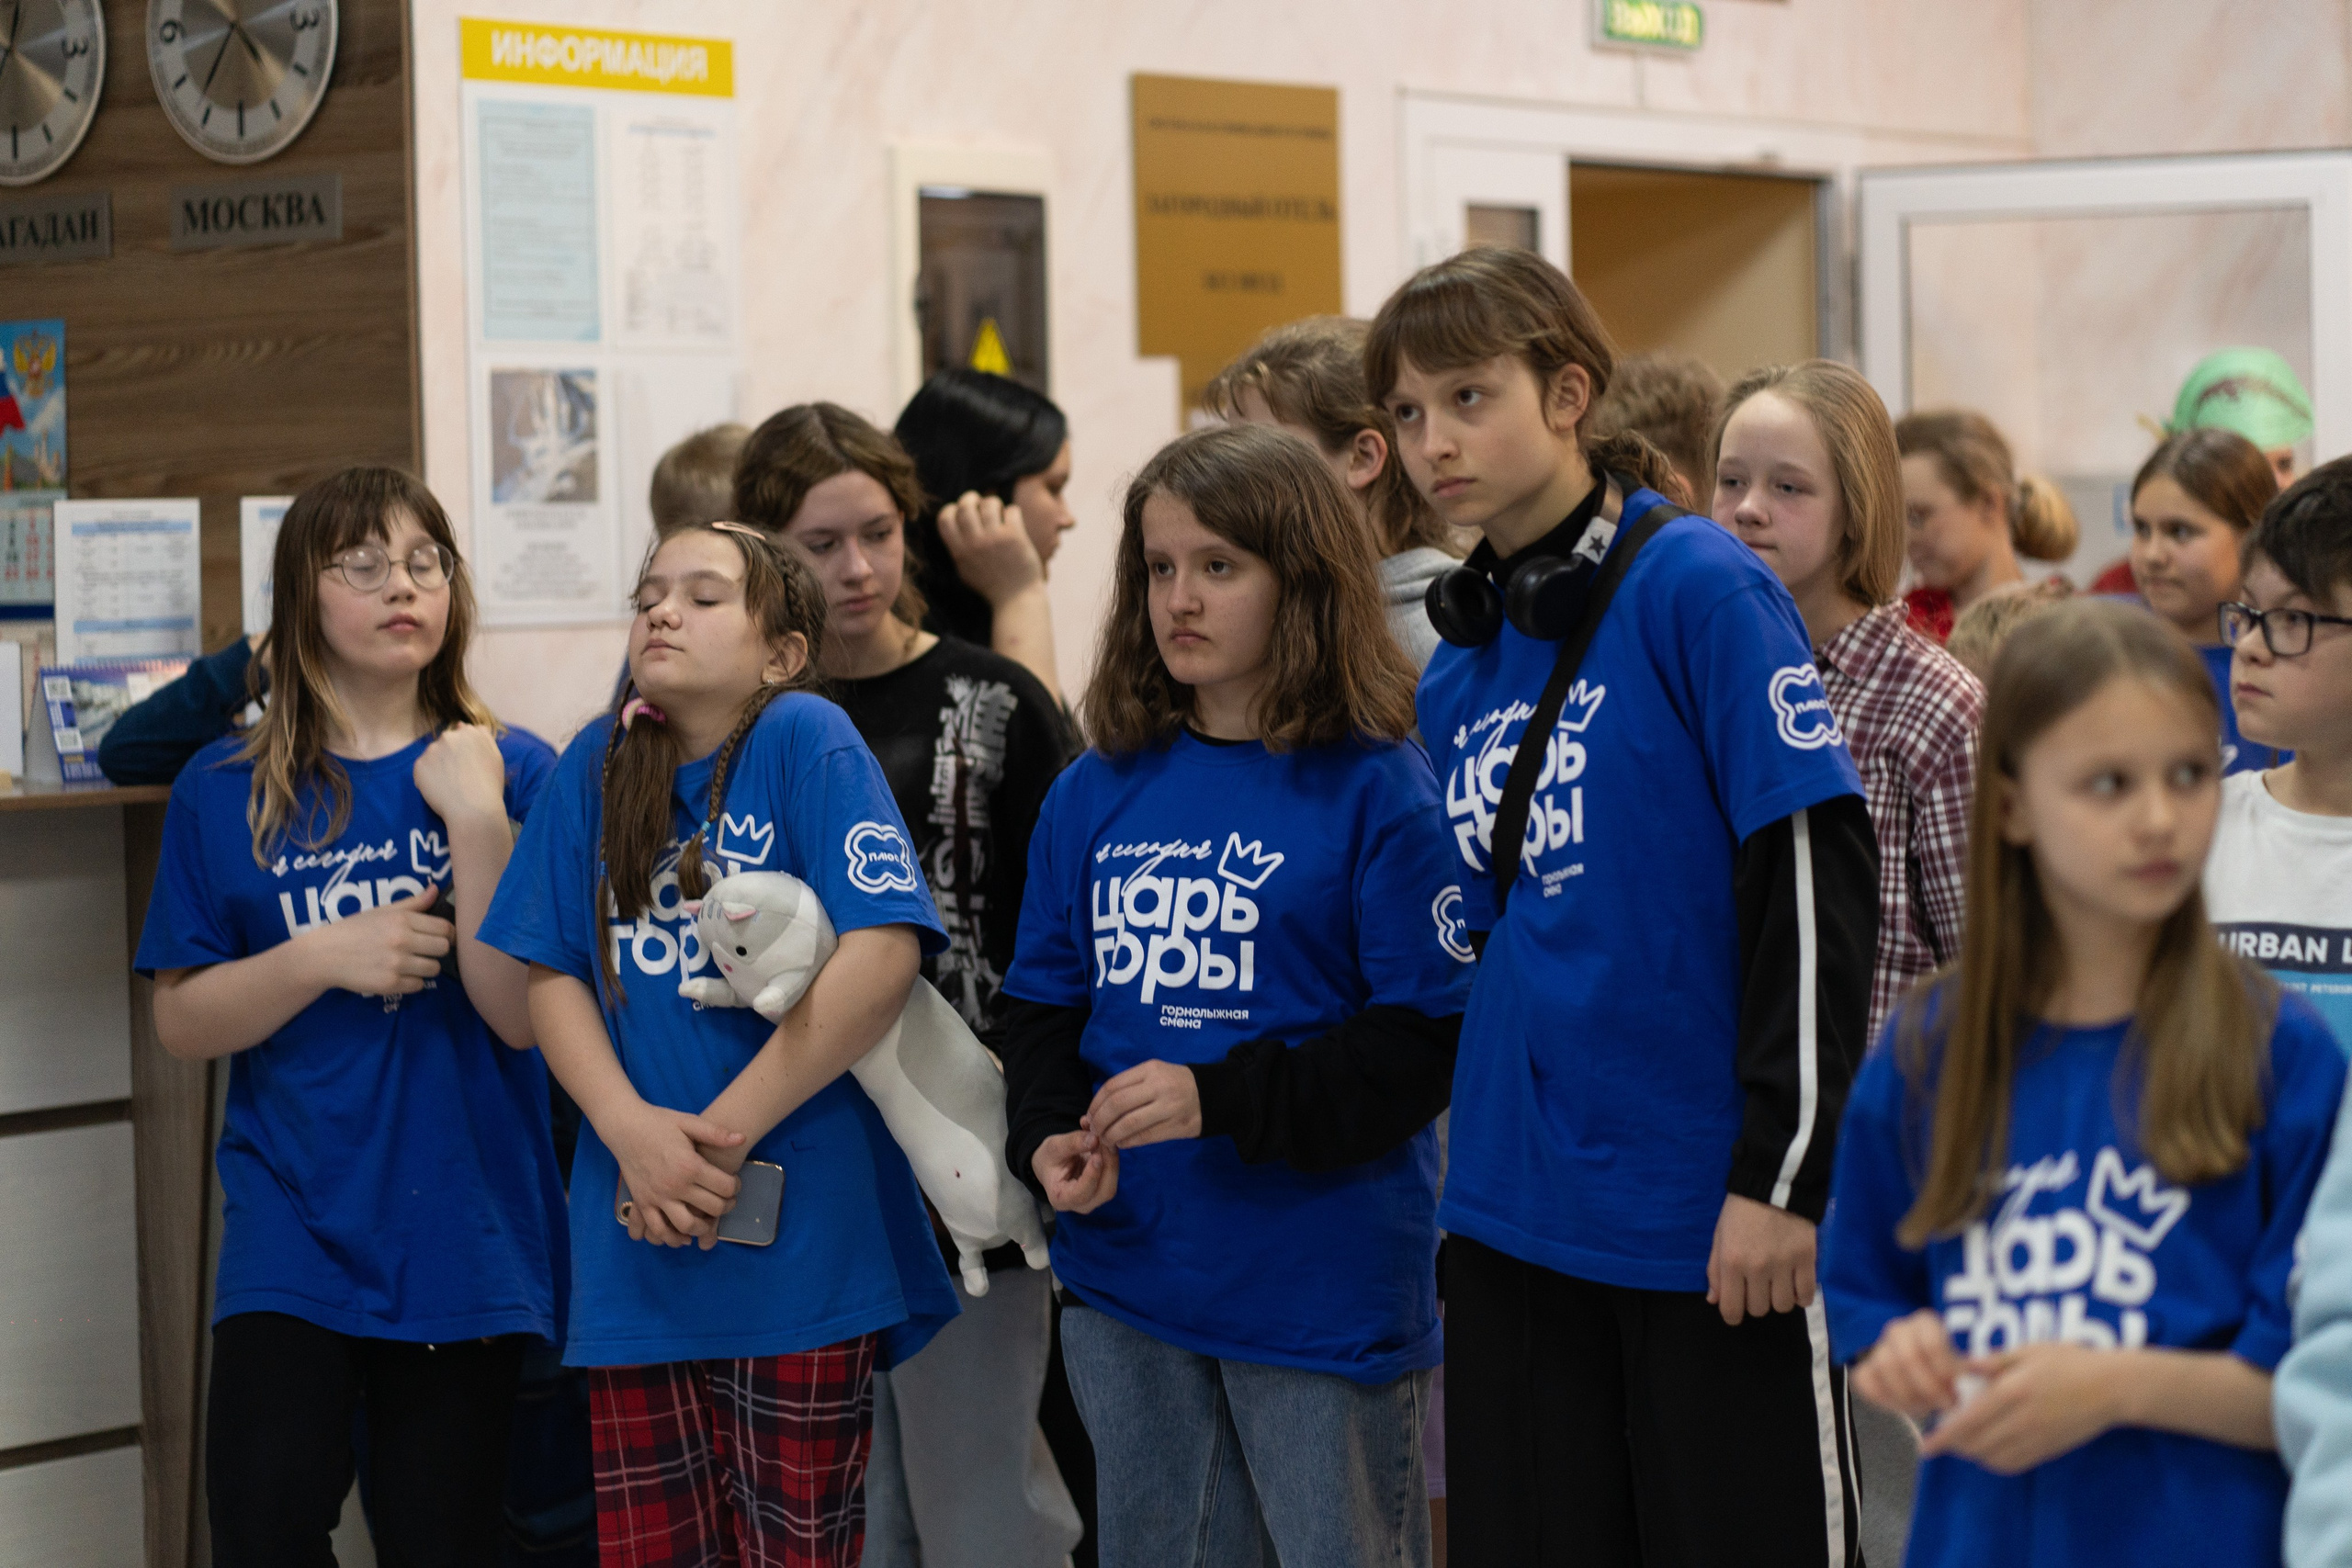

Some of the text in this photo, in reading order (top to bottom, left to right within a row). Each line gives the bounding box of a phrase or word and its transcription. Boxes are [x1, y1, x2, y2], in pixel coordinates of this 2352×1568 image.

[491, 29, 709, 85] ИНФОРМАЦИЯ
[184, 192, 326, 235] МОСКВА
[868, 852, 900, 863] ПЛЮС
[1092, 874, 1261, 941] царь
[609, 921, 711, 985] гор
[1094, 930, 1255, 1005] горы
[1159, 1017, 1203, 1030] смена
[1160, 1004, 1250, 1021] горнолыжная
